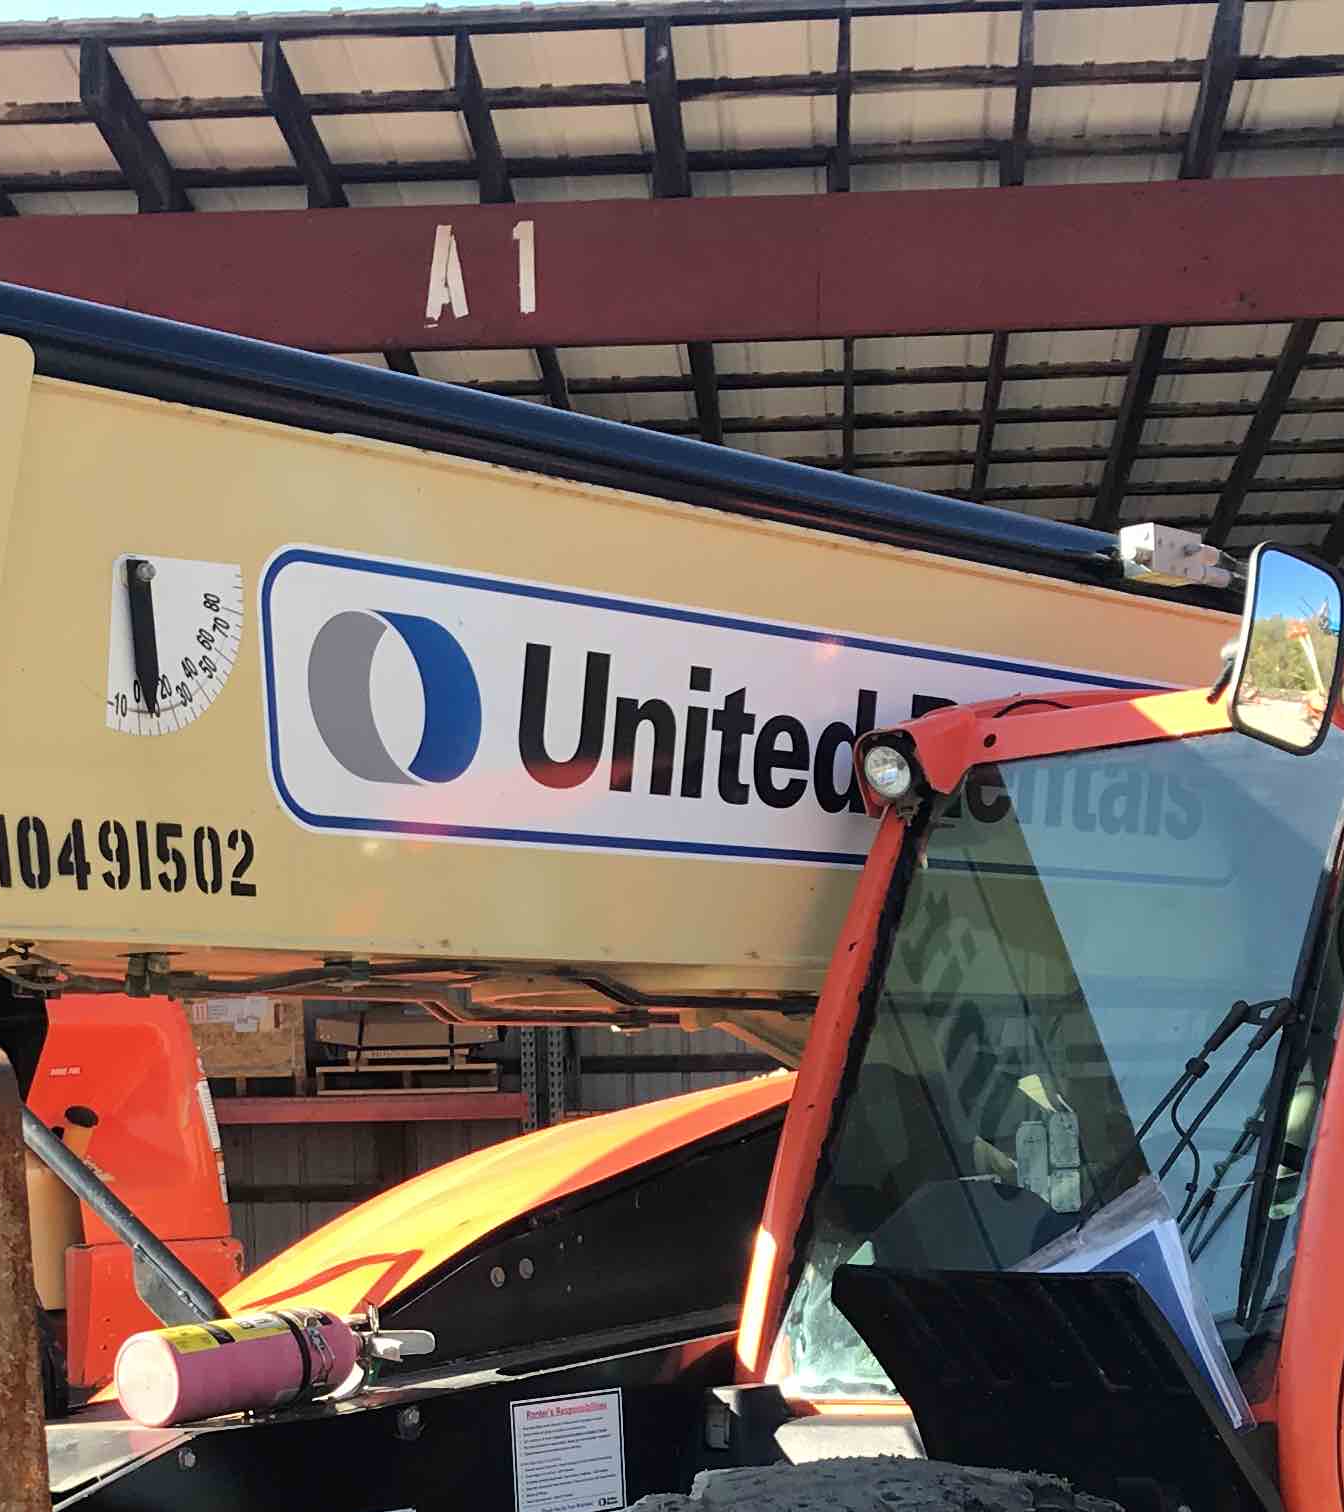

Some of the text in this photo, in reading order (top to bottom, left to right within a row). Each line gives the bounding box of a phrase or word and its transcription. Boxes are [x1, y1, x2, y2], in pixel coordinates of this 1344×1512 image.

[425, 220, 536, 322] A 1
[203, 592, 220, 612] 80
[197, 628, 215, 651] 60
[212, 617, 230, 638] 70
[181, 656, 198, 680] 40
[198, 655, 217, 679] 50
[134, 679, 141, 703] 0
[158, 674, 172, 700] 20
[176, 681, 193, 707] 30
[517, 643, 1205, 840] United entals
